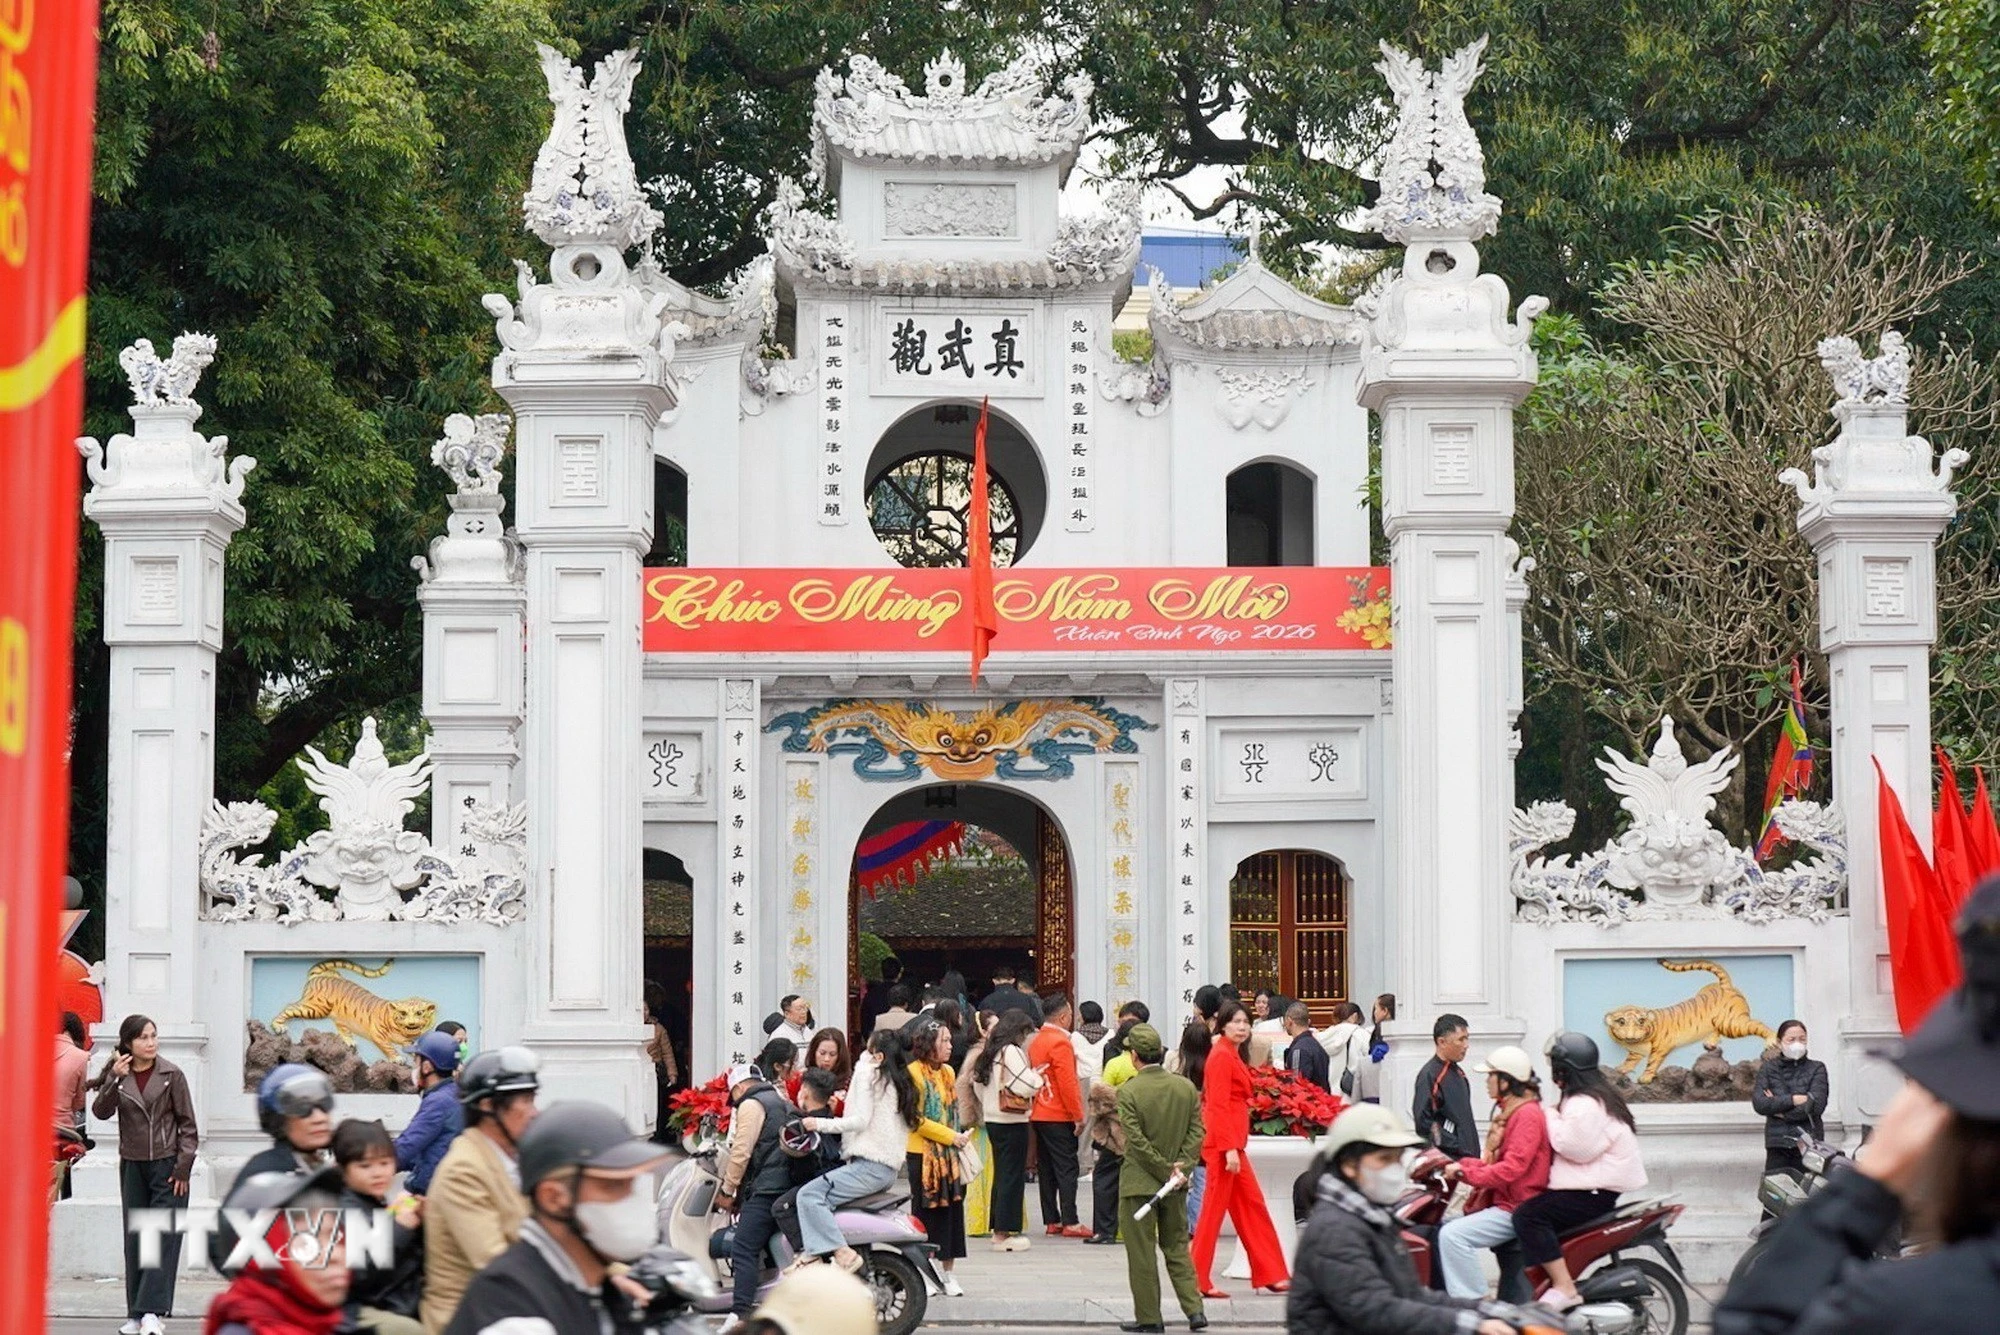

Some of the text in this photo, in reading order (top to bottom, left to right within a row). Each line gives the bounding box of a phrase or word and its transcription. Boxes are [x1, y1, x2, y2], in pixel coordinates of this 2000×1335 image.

[646, 573, 1290, 638] Chúc Mừng Năm Mới
[1053, 624, 1317, 645] Xuân Bính Ngọ 2026
